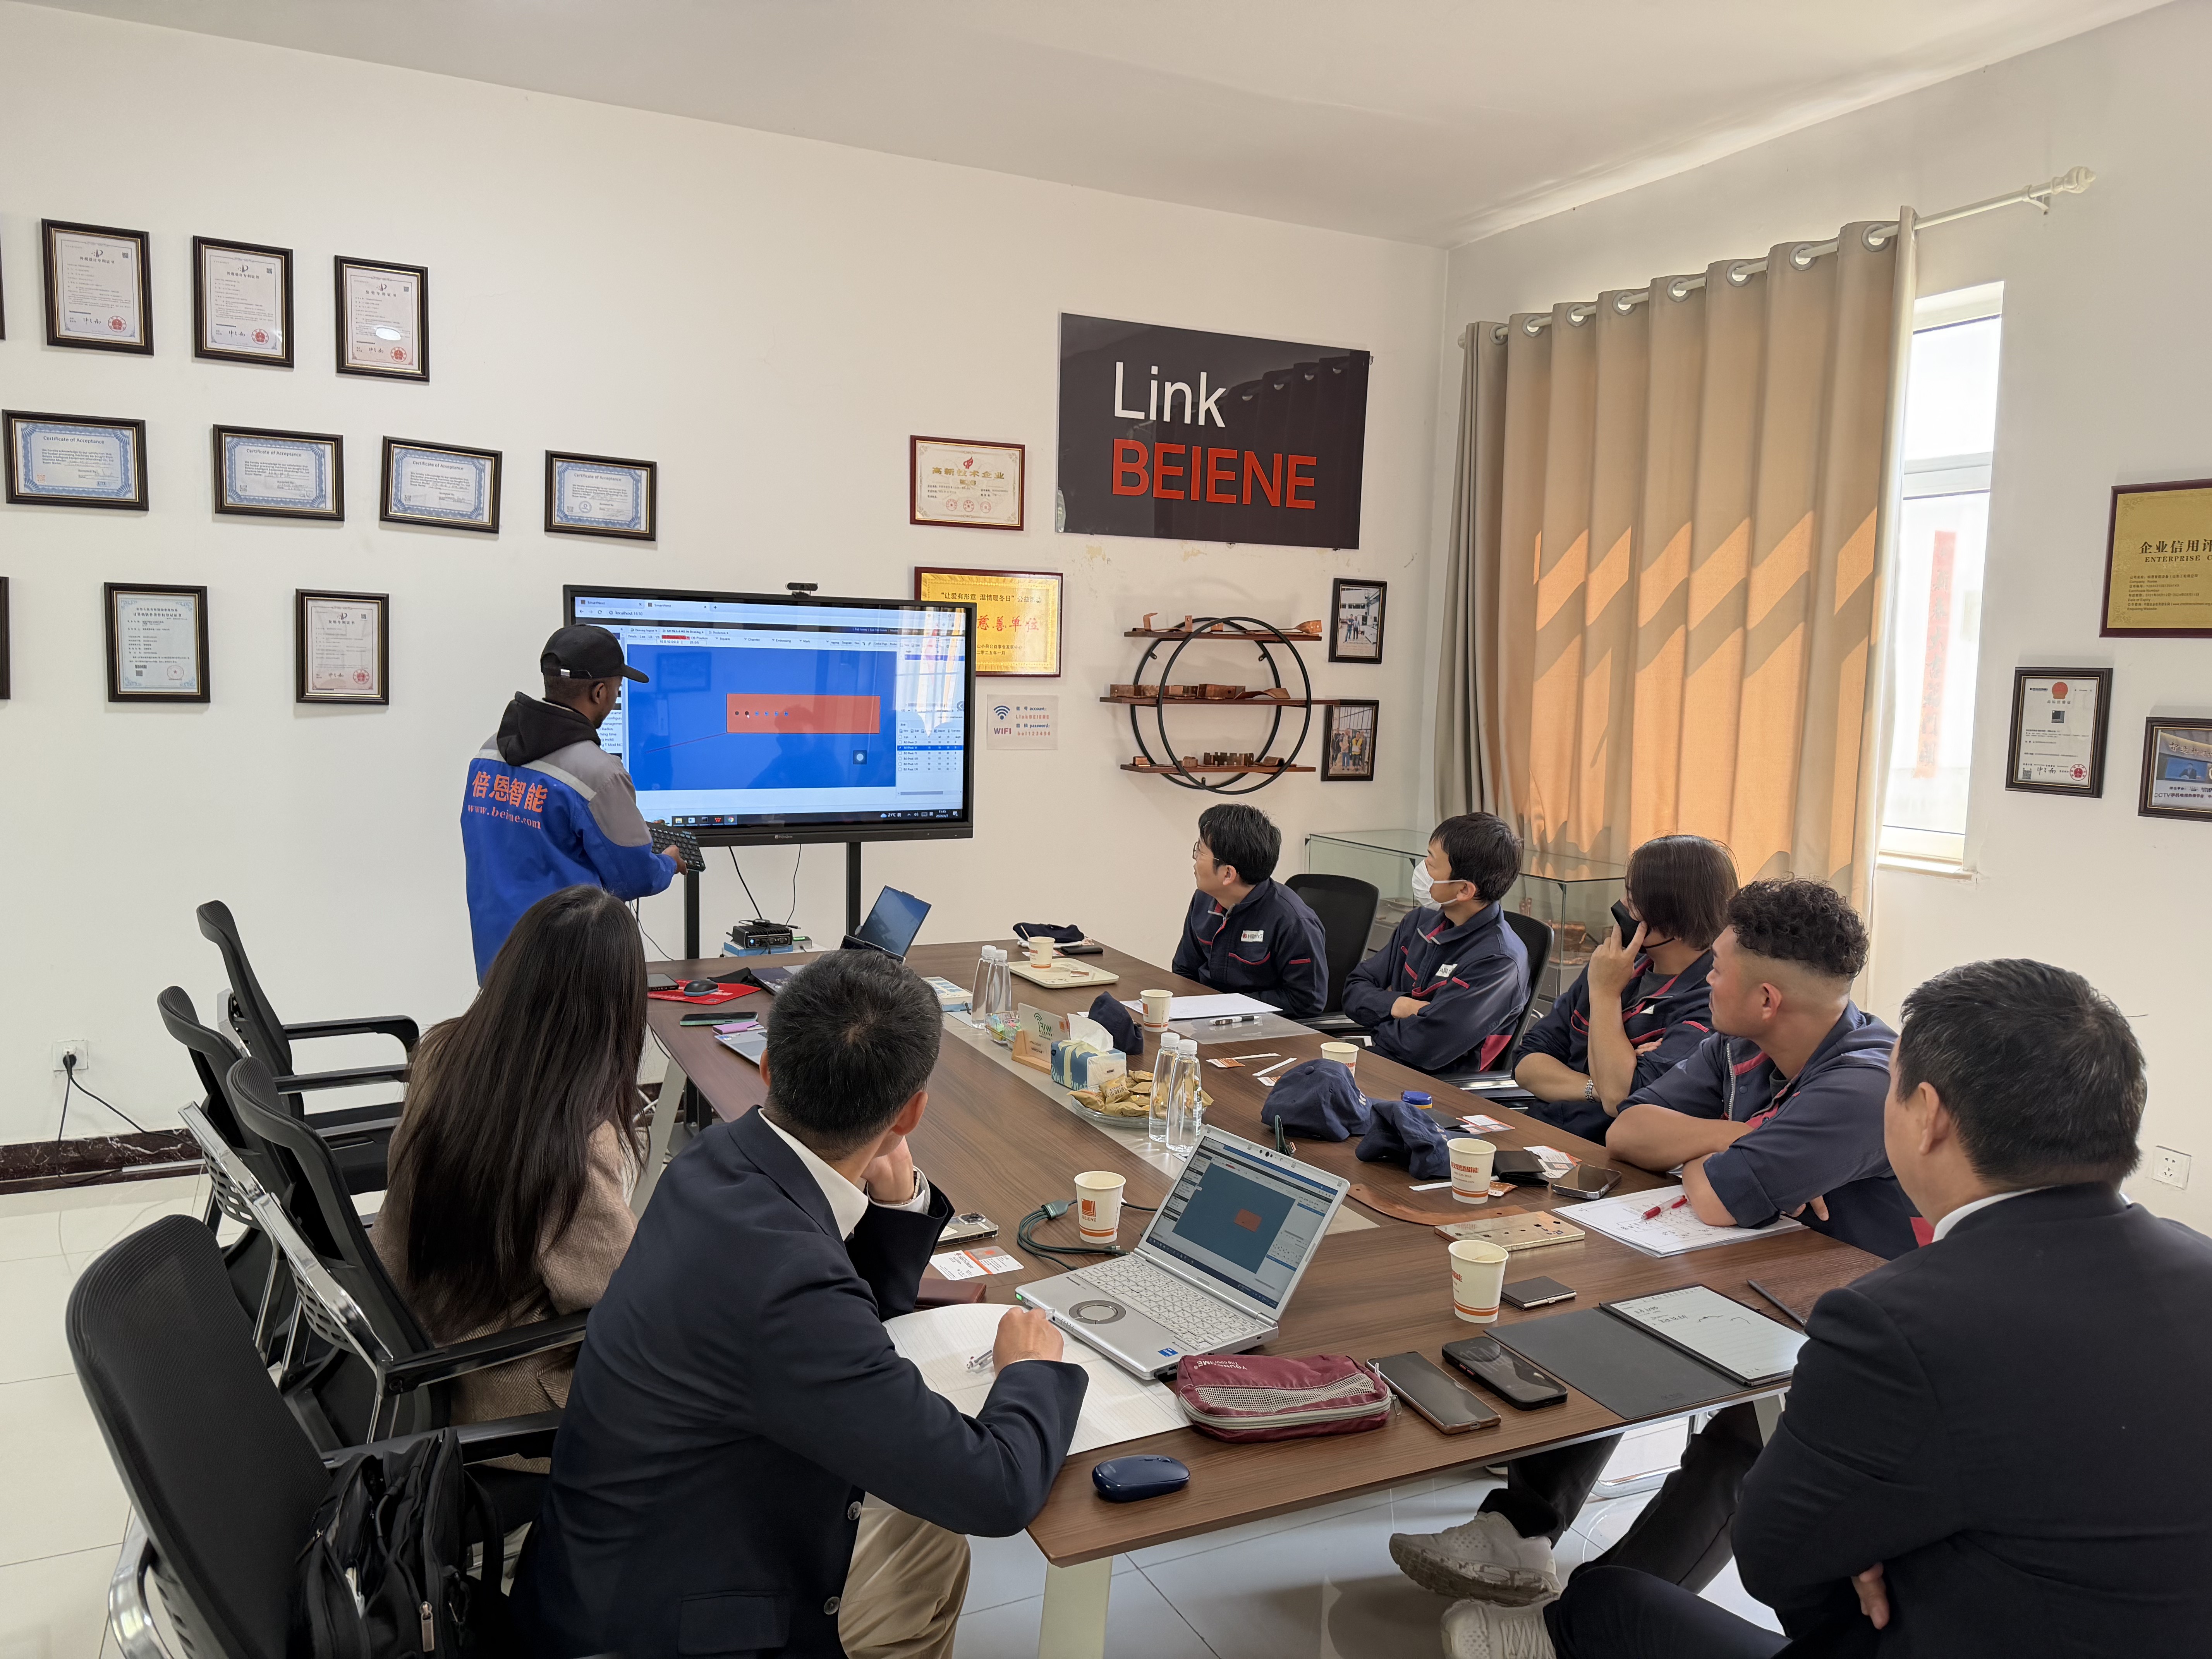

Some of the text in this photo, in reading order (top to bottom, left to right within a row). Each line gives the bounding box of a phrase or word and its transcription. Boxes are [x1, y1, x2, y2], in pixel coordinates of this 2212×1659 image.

[1114, 362, 1226, 427] Link
[933, 467, 1004, 479] 高新技术企业
[1112, 438, 1317, 509] BEIENE
[977, 615, 1039, 632] 慈善单位
[472, 771, 548, 813] 倍恩智能
